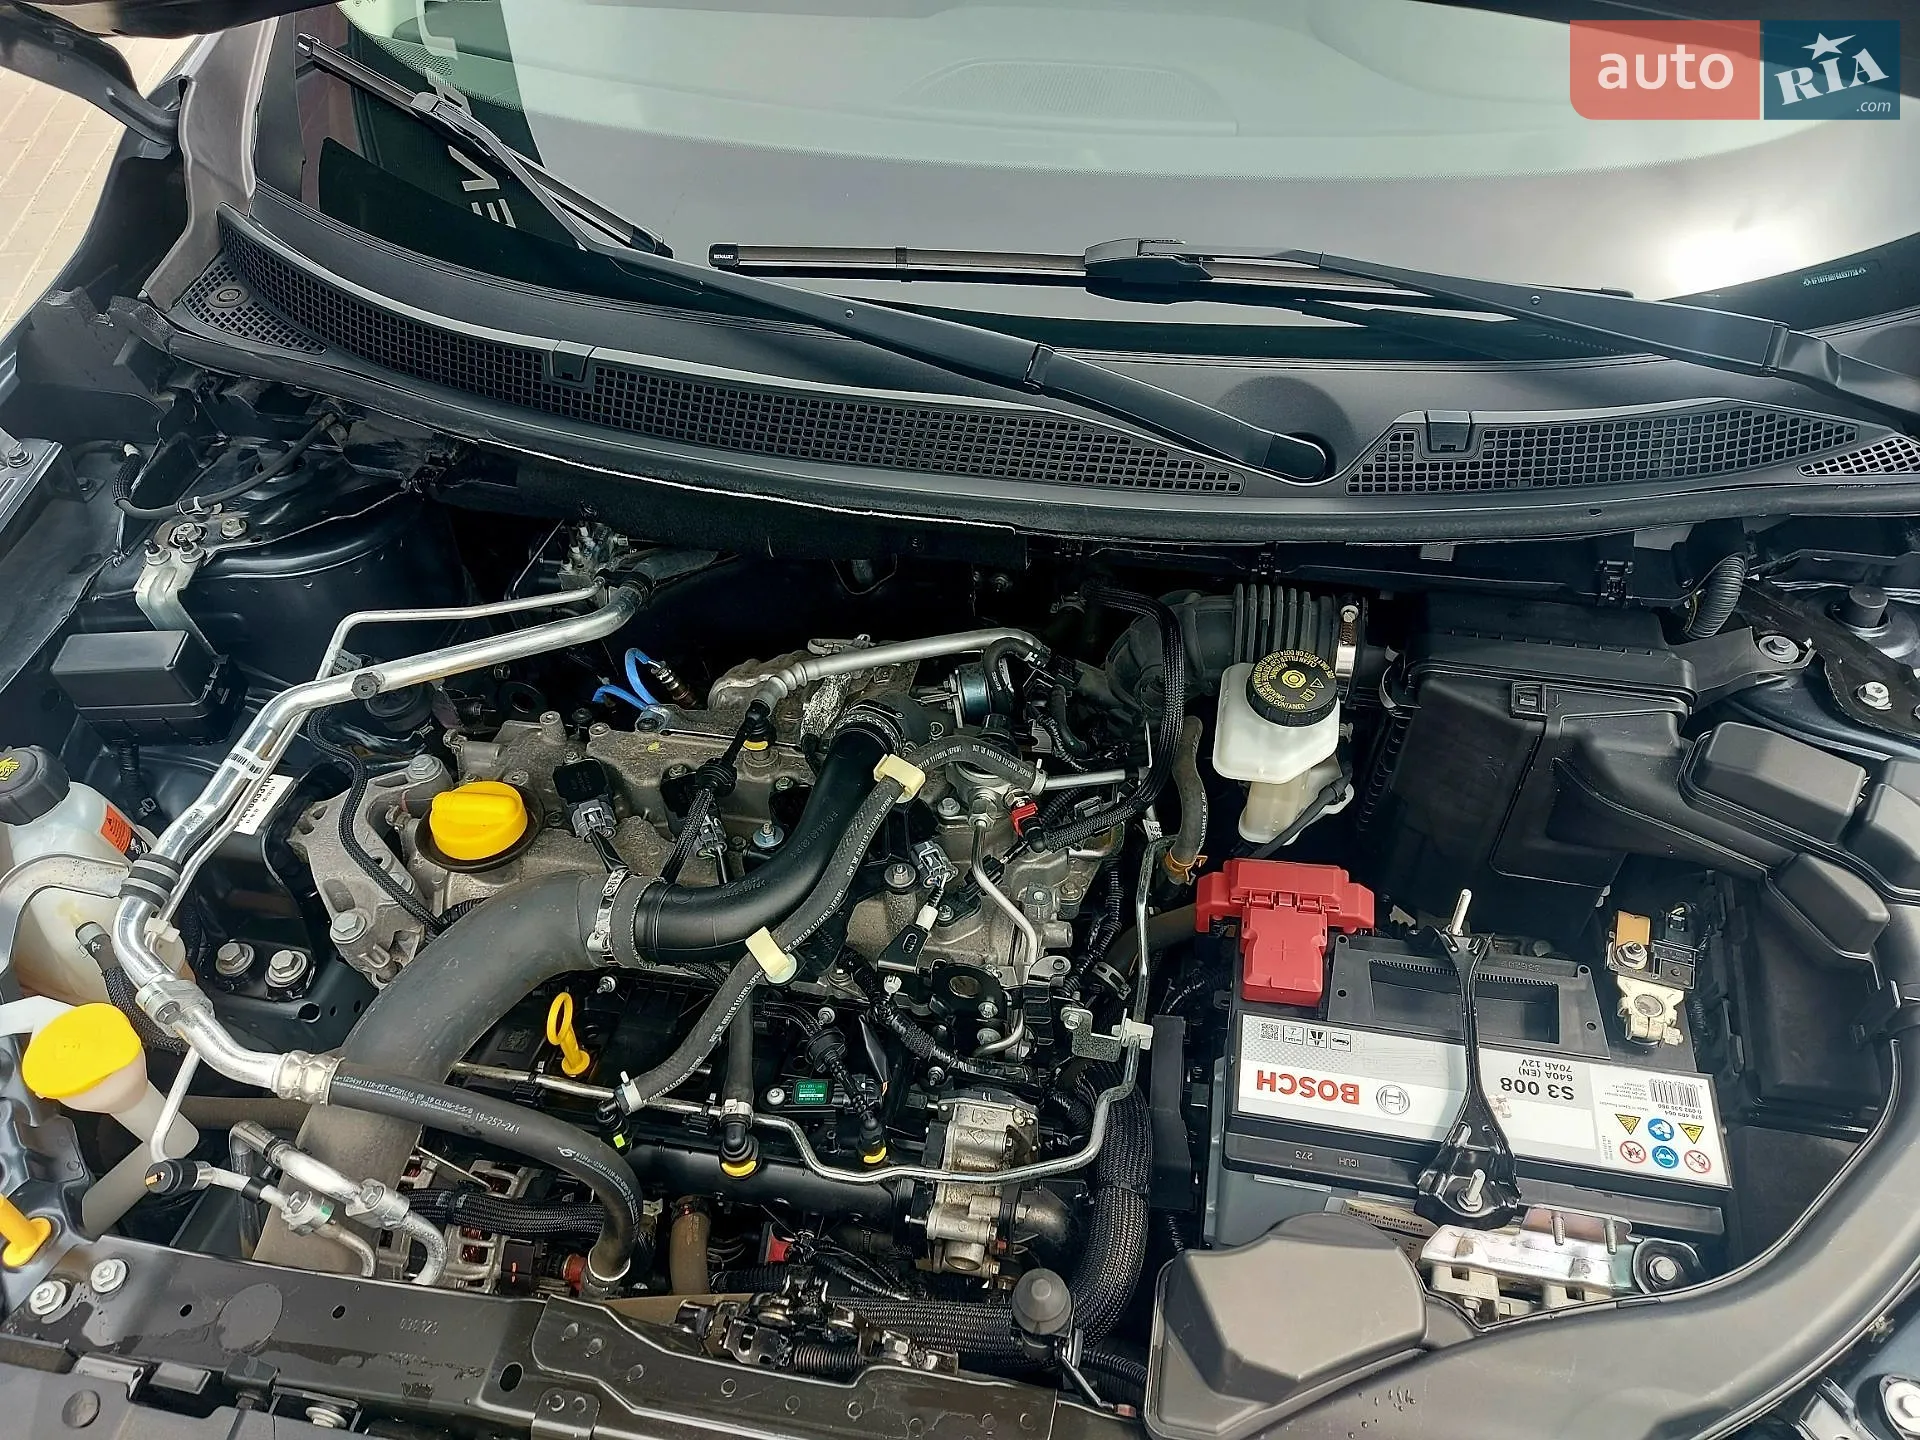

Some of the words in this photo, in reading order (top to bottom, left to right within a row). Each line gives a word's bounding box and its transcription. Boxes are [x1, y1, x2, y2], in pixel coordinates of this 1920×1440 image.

[1521, 1059, 1540, 1068] 12V
[1544, 1062, 1573, 1073] 70Ah
[1518, 1066, 1541, 1078] (EN)
[1544, 1071, 1573, 1082] 640A
[1257, 1070, 1359, 1104] BOSCH
[1499, 1077, 1540, 1096] 008
[1548, 1085, 1575, 1101] S3
